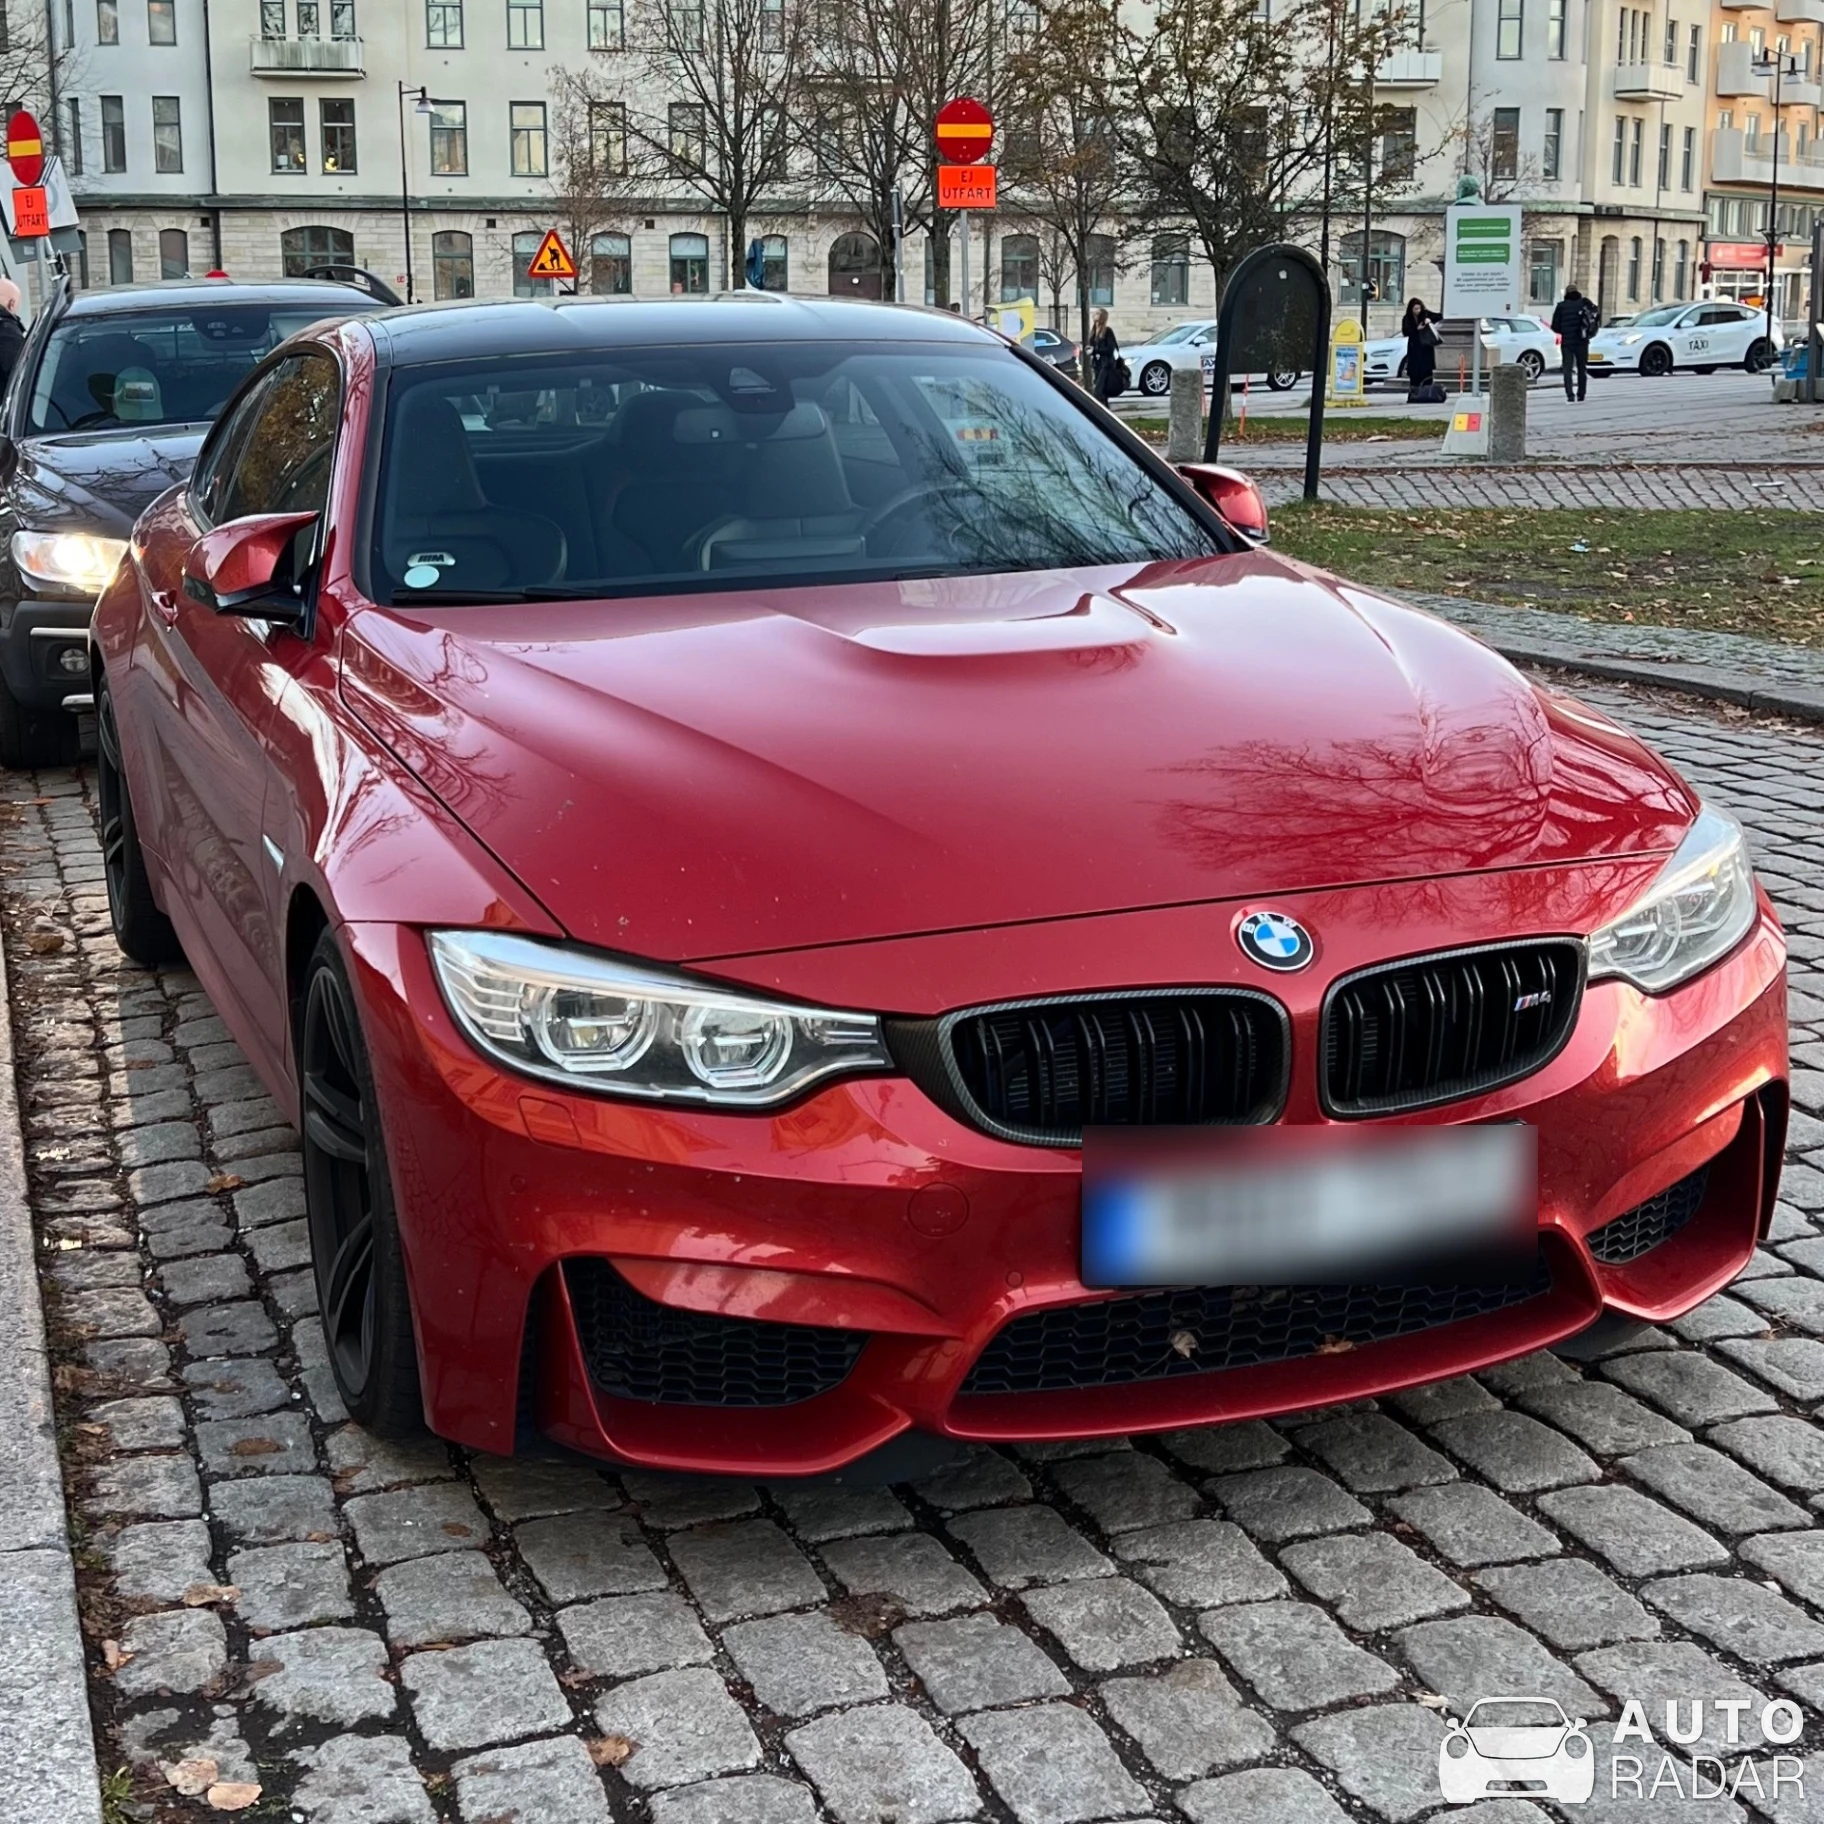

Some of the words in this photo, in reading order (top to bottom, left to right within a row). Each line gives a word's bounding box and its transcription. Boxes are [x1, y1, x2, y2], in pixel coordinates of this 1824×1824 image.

[961, 170, 973, 183] EJ
[942, 187, 992, 199] UTFART
[25, 195, 34, 208] EJ
[17, 213, 45, 228] UTFART
[1688, 339, 1709, 351] TAXI
[1241, 913, 1298, 935] BMW
[1523, 990, 1551, 1008] M4
